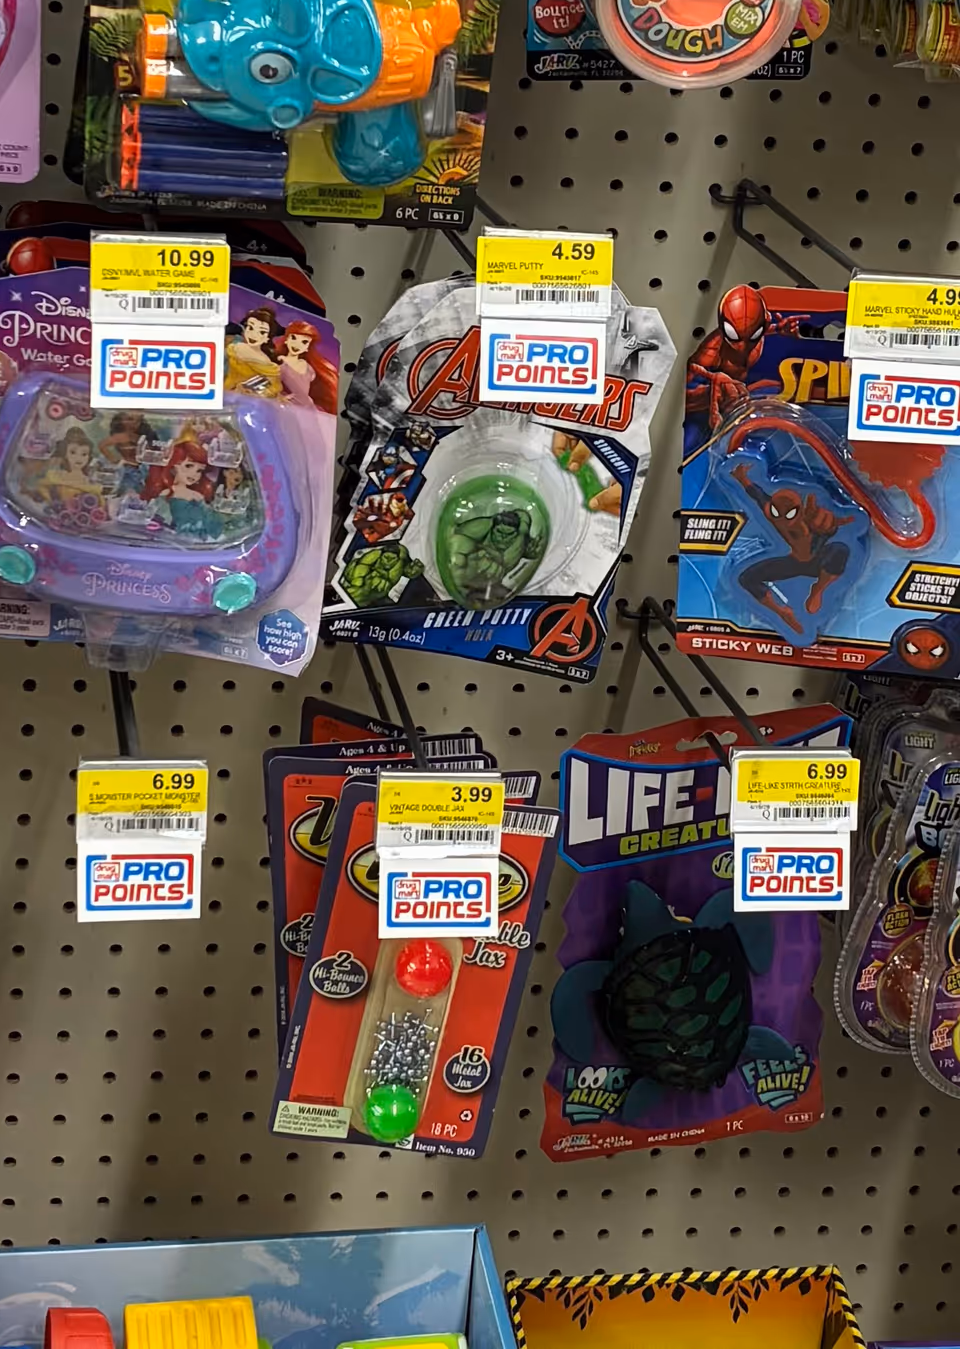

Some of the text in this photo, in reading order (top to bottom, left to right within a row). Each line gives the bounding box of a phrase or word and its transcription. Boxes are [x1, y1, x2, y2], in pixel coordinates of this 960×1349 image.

[634, 13, 723, 53] DOUGH
[156, 249, 215, 268] 10.99
[551, 243, 596, 260] 4.59
[865, 305, 920, 314] MARVEL STICKY
[141, 347, 206, 371] PRO
[526, 342, 589, 364] PRO
[109, 368, 206, 391] POINTS
[496, 363, 588, 386] POINTS
[895, 385, 956, 405] PRO
[865, 405, 953, 427] POINTS
[687, 518, 731, 530] SLING IT!
[684, 529, 727, 541] FLING IT!
[905, 592, 951, 604] OBJECTS!
[909, 583, 956, 595] STICKS TO
[481, 608, 534, 625] PUTTY
[368, 626, 426, 645] 13g (0.4oz)
[692, 638, 751, 652] STICKY
[757, 642, 793, 656] WEB
[152, 772, 195, 790] 6.99
[807, 763, 847, 780] 6.99
[451, 786, 492, 803] 3.99
[122, 862, 185, 882] PRO
[776, 854, 835, 874] PRO
[94, 882, 185, 902] POINTS
[422, 879, 483, 900] PRO
[750, 875, 834, 894] POINTS
[395, 900, 482, 920] POINTS
[333, 951, 351, 970] 2
[314, 969, 364, 984] Hi-Bounce
[323, 979, 350, 994] Balls
[757, 1065, 810, 1097] ALIVE!
[431, 1122, 458, 1138] 18 PC
